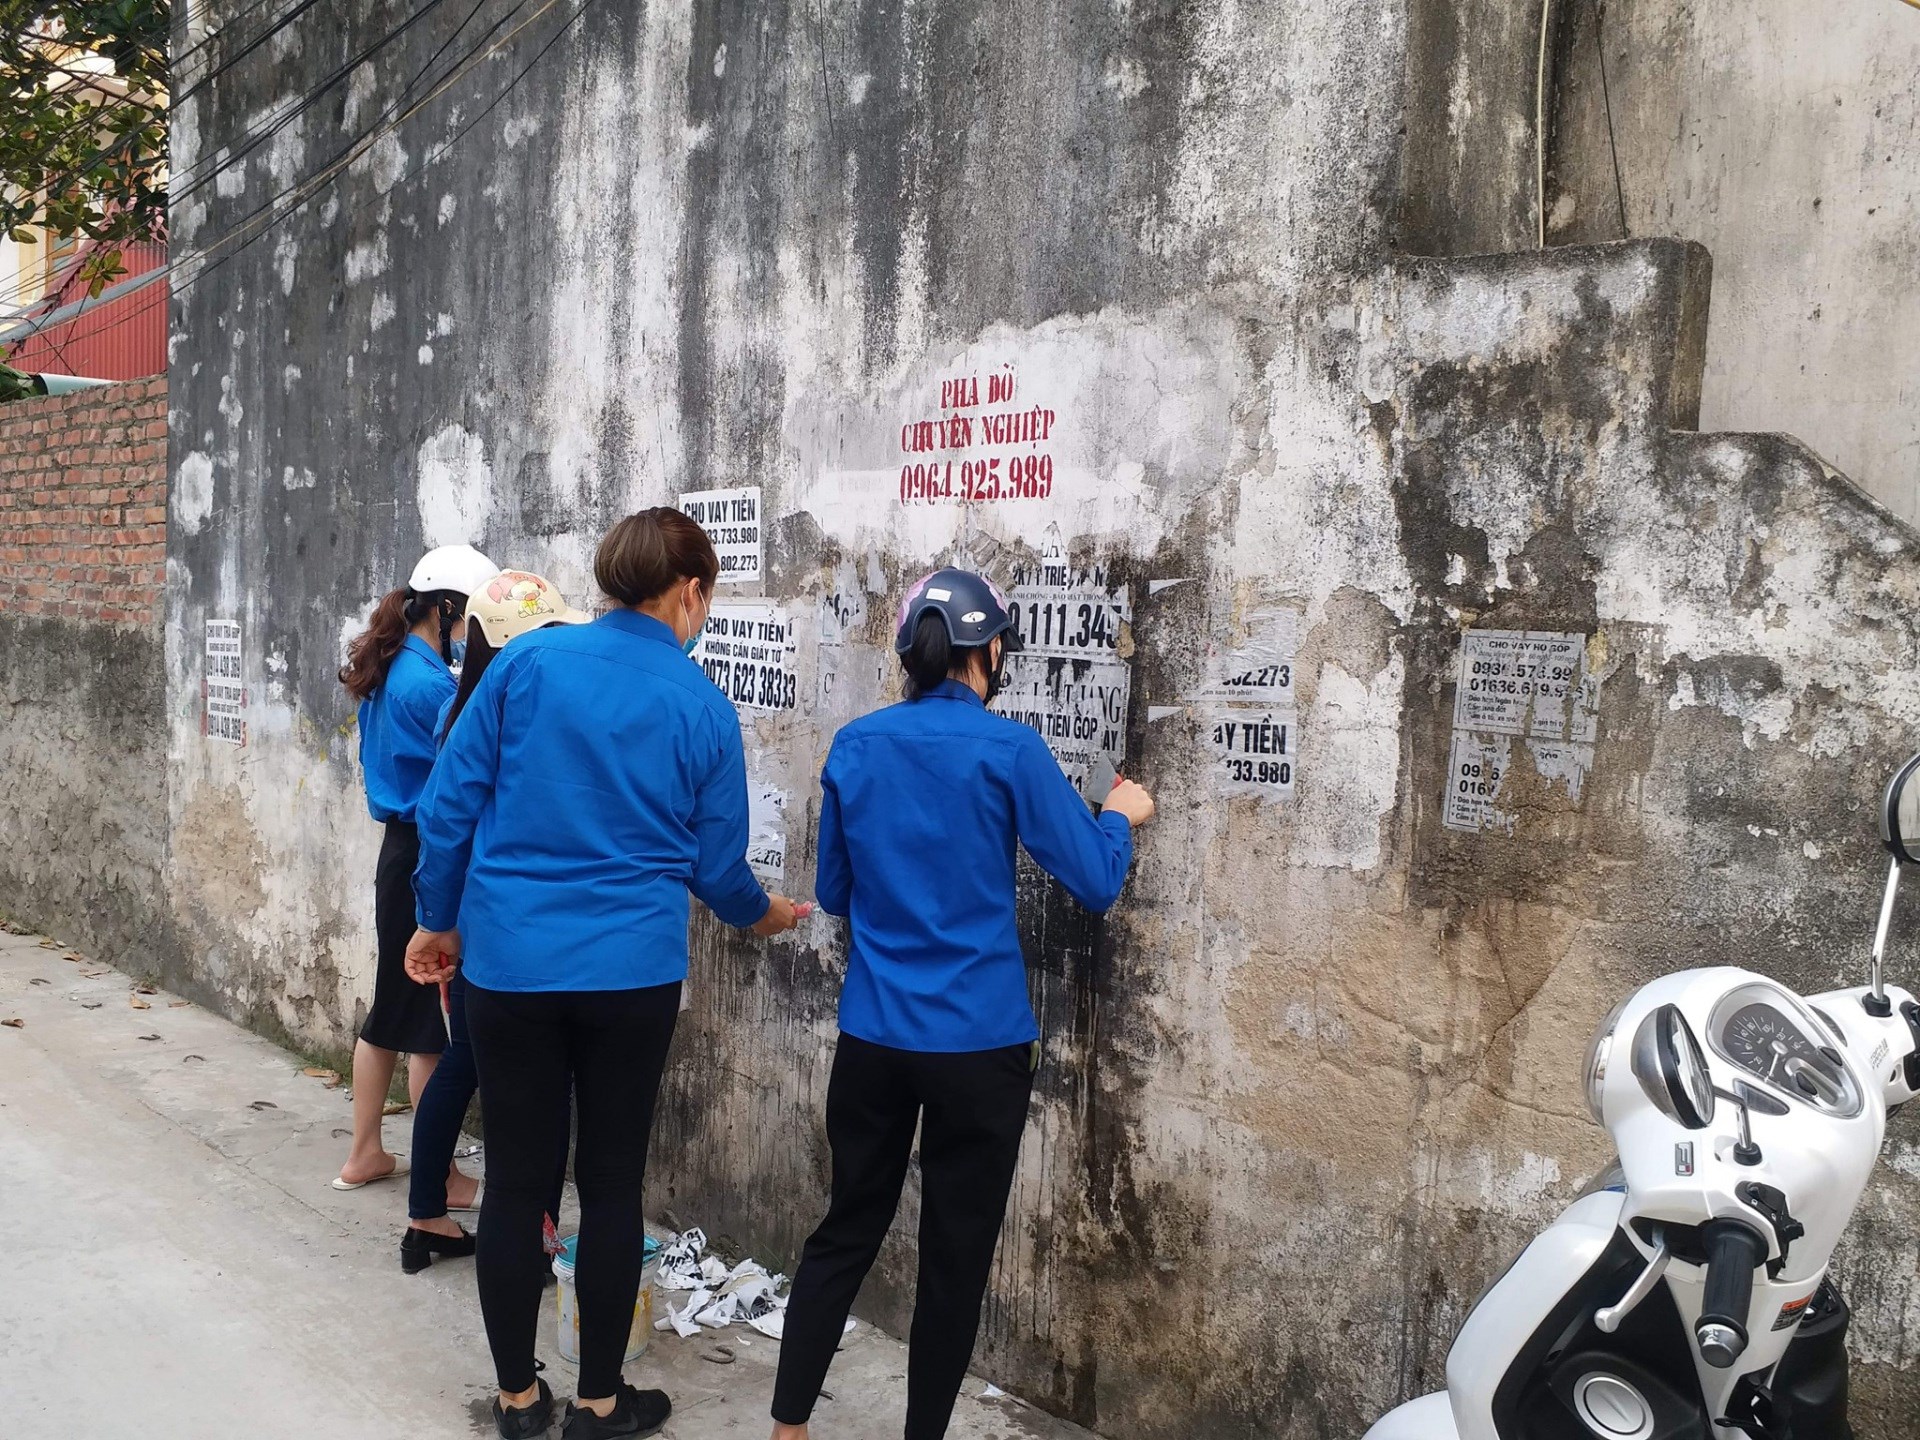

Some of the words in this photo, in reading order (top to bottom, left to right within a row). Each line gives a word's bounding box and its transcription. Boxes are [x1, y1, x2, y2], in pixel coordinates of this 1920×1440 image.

[941, 369, 979, 409] PHÁ
[901, 413, 974, 453] CHUYÊN
[981, 404, 1055, 449] NGHIỆP
[900, 454, 1053, 506] 0964.925.989
[684, 501, 704, 524] CHO
[708, 500, 728, 523] VAY
[731, 491, 756, 522] TIỀN
[705, 616, 728, 636] CHO
[732, 619, 755, 640] VAY
[758, 617, 785, 643] TIỀN
[1489, 640, 1509, 649] CHO
[1511, 643, 1531, 651] VAY
[704, 639, 731, 656] KHÔNG
[751, 643, 770, 662] GIẤY
[733, 662, 756, 704] 623
[1046, 705, 1071, 738] TIỀN
[1242, 713, 1287, 754] TIỀN
